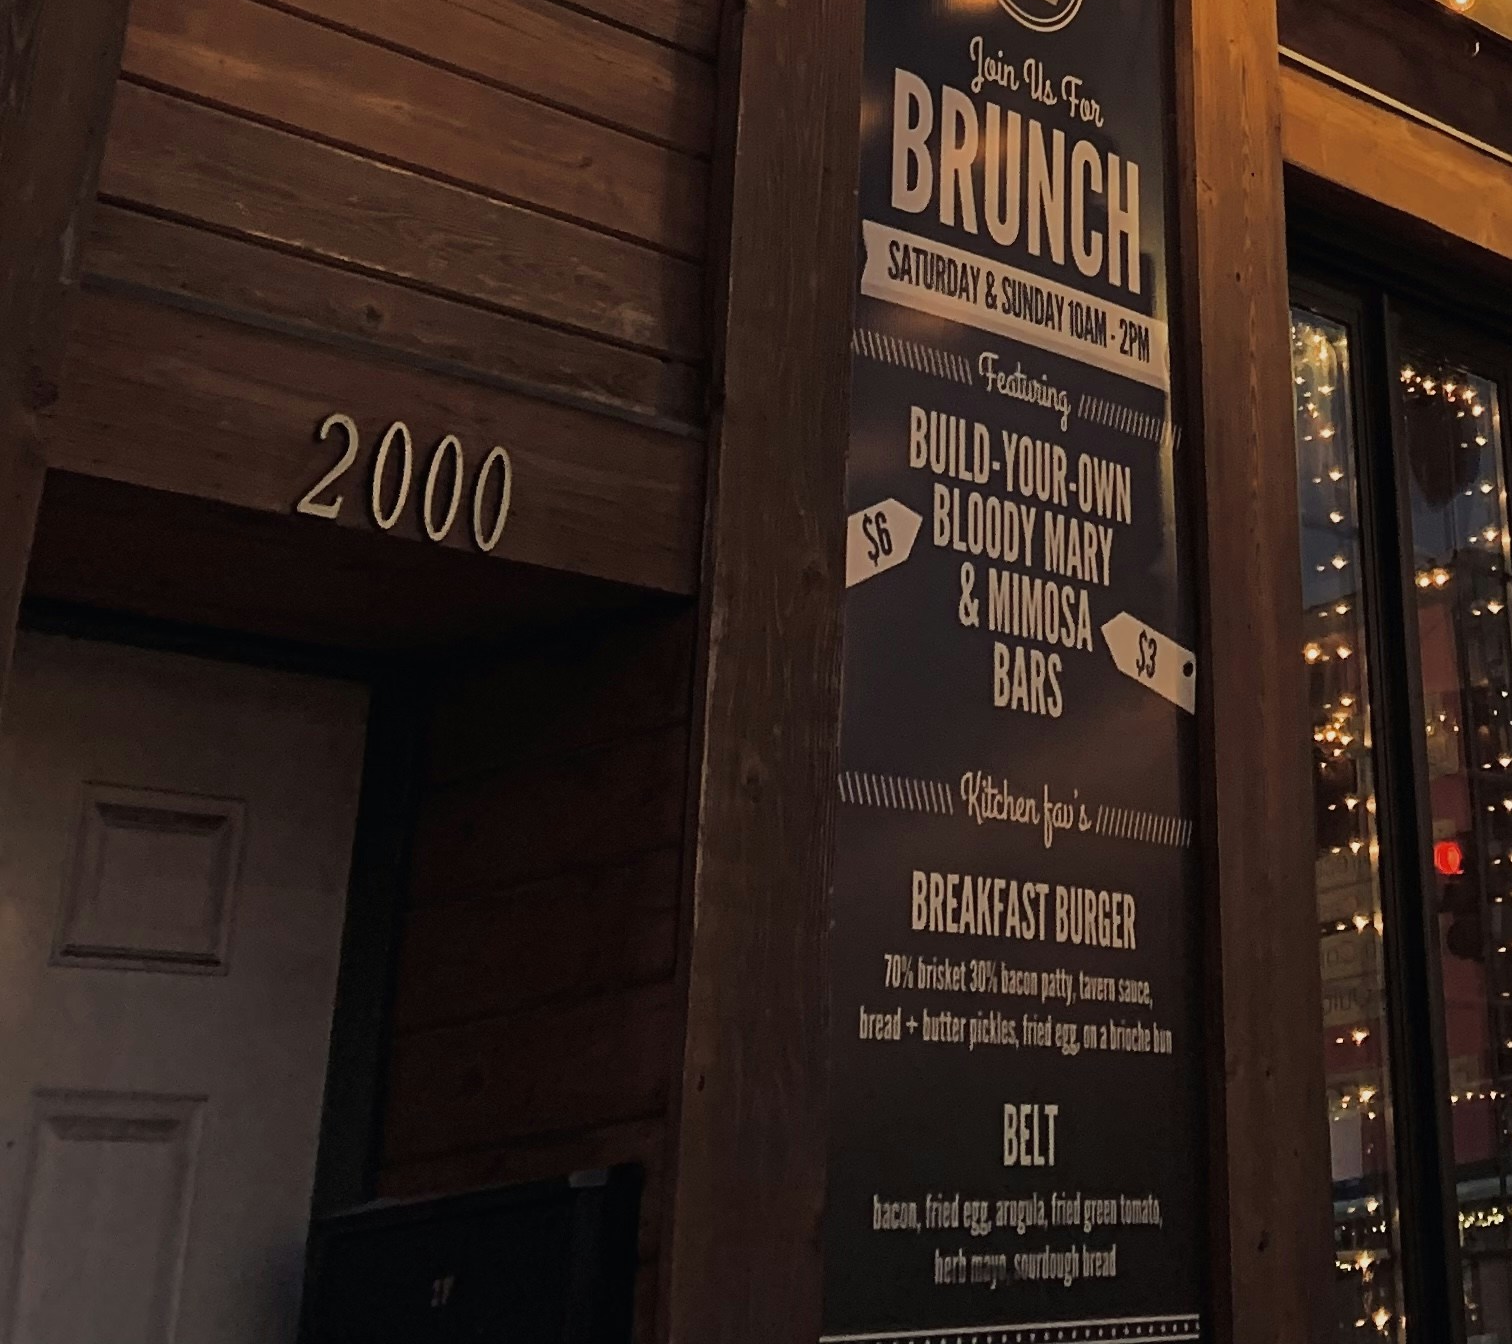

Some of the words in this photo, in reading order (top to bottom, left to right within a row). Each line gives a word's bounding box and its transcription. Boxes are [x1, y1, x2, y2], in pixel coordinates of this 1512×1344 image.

[970, 36, 1019, 93] Join
[1023, 59, 1056, 107] Us
[1061, 75, 1104, 128] For
[892, 68, 1141, 295] BRUNCH
[888, 240, 981, 304] SATURDAY
[984, 271, 998, 311] &
[1001, 276, 1066, 334] SUNDAY
[1067, 298, 1107, 347] 10AM
[1119, 319, 1150, 365] 2PM
[978, 352, 1071, 431] Featuring
[297, 413, 512, 551] 2000
[910, 406, 1131, 525] BUILD-YOUR-OWN
[862, 511, 892, 567] $6
[933, 484, 1036, 567] BLOODY
[1045, 510, 1113, 586] MARY
[958, 562, 979, 628] &
[988, 568, 1092, 651] MIMOSA
[994, 642, 1062, 718] BARS
[1136, 629, 1157, 679] $3
[961, 770, 1038, 826] Kitchen
[1042, 784, 1091, 848] fav's
[912, 871, 1048, 940] BREAKFAST
[1055, 886, 1136, 950] BURGER
[884, 953, 913, 989] 70%
[918, 955, 966, 992] brisket
[970, 959, 998, 994] 30%
[1001, 961, 1037, 996] bacon
[1041, 968, 1076, 1006] patty,
[1079, 970, 1115, 1002] tavern
[1118, 977, 1153, 1009] sauce,
[859, 1005, 901, 1040] bread
[906, 1016, 918, 1036] +
[922, 1007, 966, 1042] butter
[969, 1009, 1019, 1052] pickles,
[1022, 1013, 1052, 1048] fried
[1083, 1026, 1097, 1050] on
[1099, 1029, 1107, 1051] a
[1110, 1018, 1150, 1053] brioche
[1153, 1021, 1172, 1055] bun
[1003, 1104, 1058, 1166] BELT
[873, 1193, 922, 1233] bacon,
[926, 1192, 960, 1229] fried
[996, 1191, 1048, 1235] arugula,
[1052, 1191, 1081, 1225] fried
[1083, 1198, 1117, 1233] green
[1120, 1192, 1163, 1230] tomato,
[934, 1248, 967, 1285] herb
[1014, 1244, 1079, 1288] sourdough
[1082, 1243, 1116, 1277] bread
